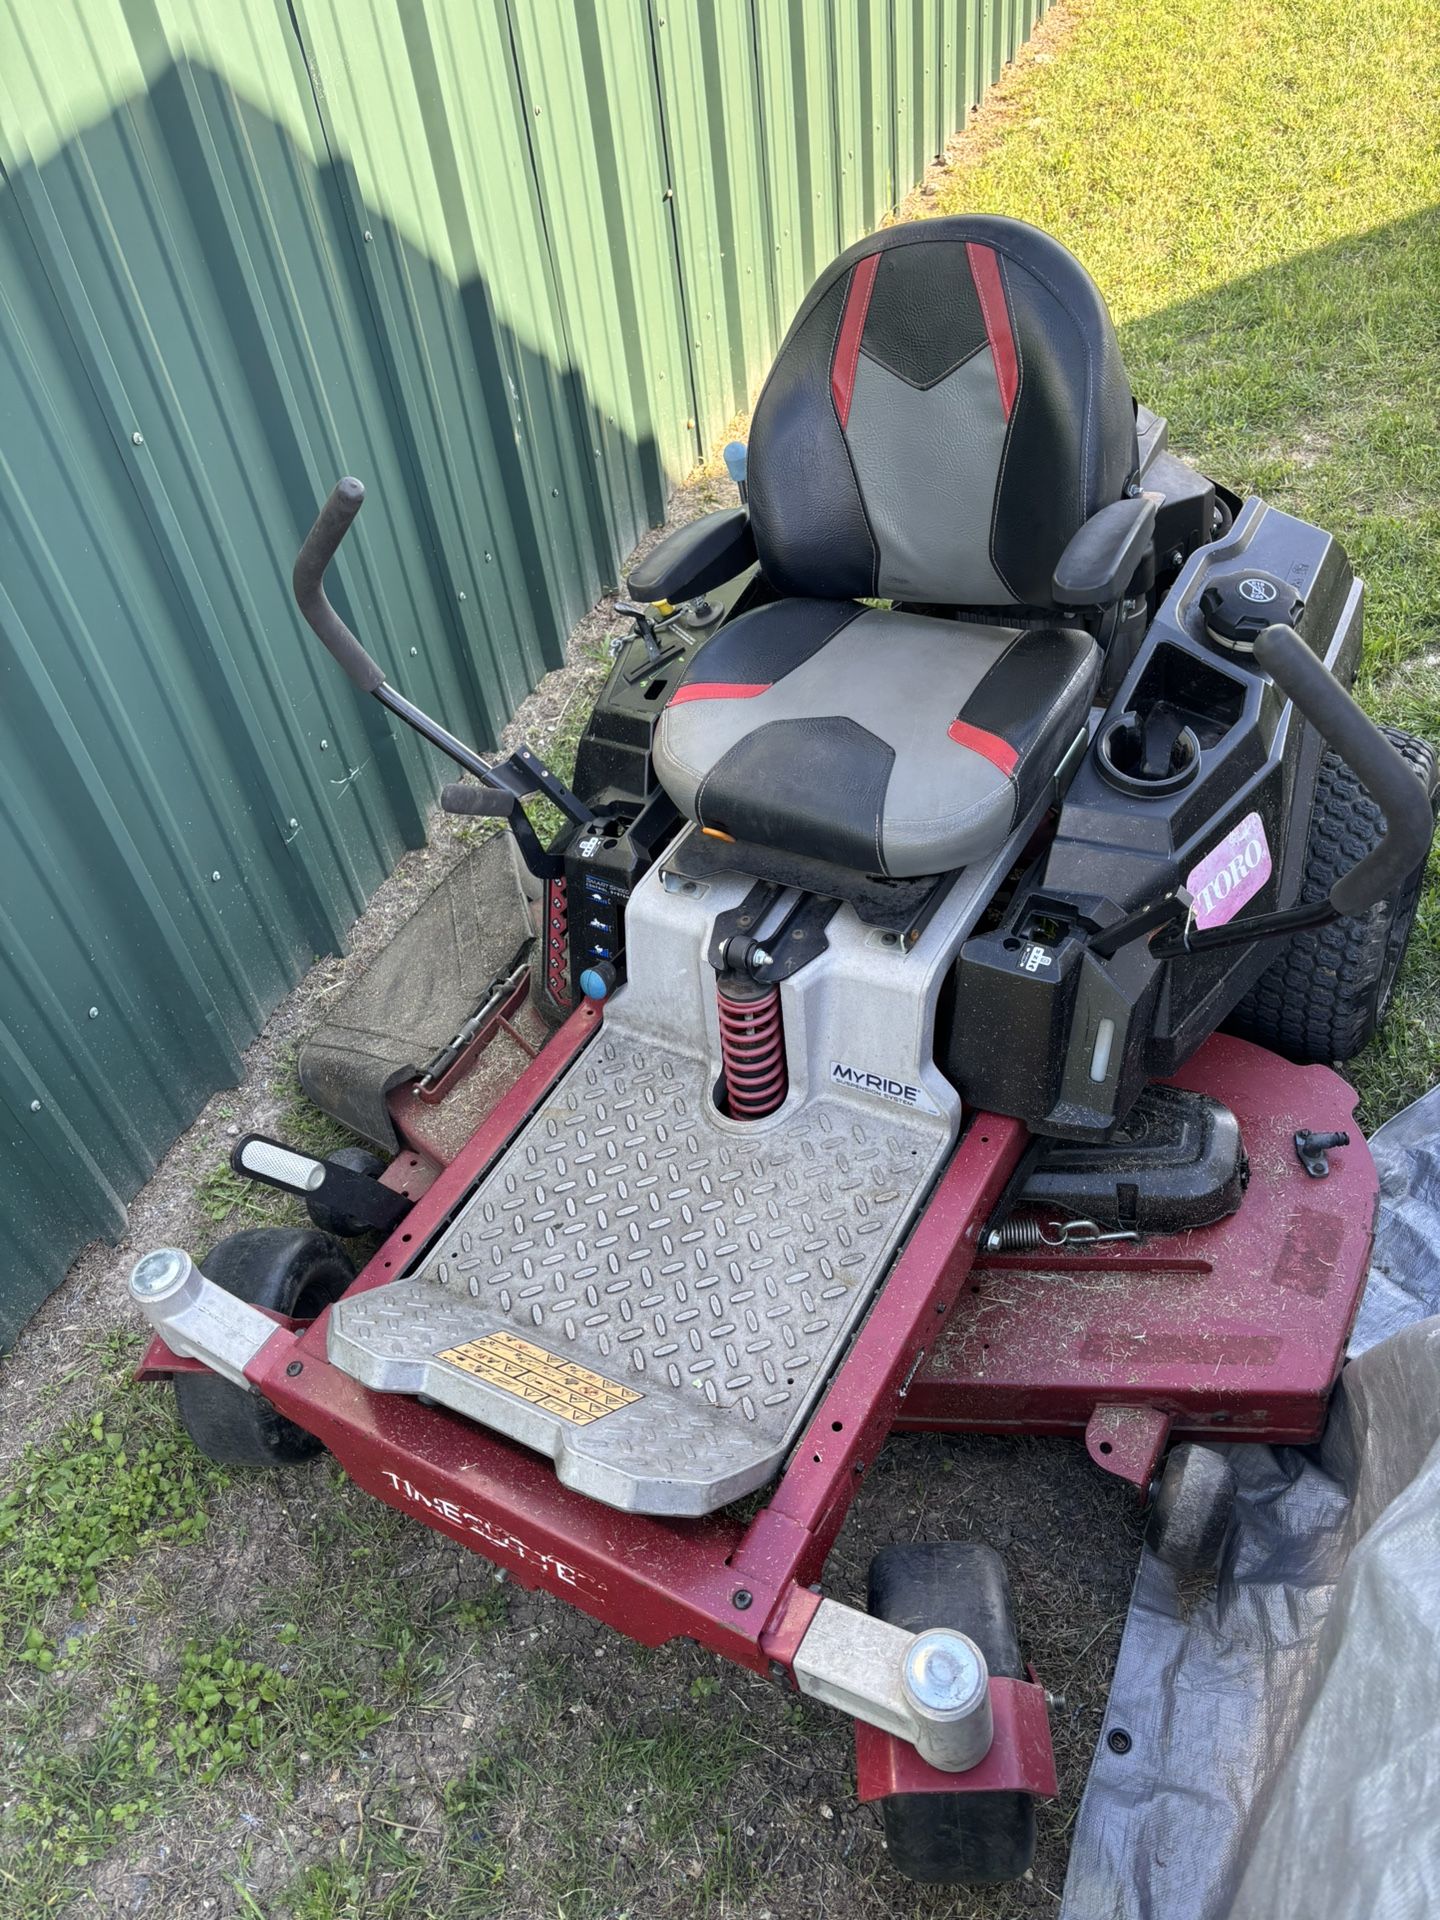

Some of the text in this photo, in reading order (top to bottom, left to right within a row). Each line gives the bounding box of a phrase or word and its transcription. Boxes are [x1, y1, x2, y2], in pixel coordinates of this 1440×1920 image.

[1196, 839, 1265, 915] TORO
[835, 1078, 914, 1107] SUSPENSION SYSTEM
